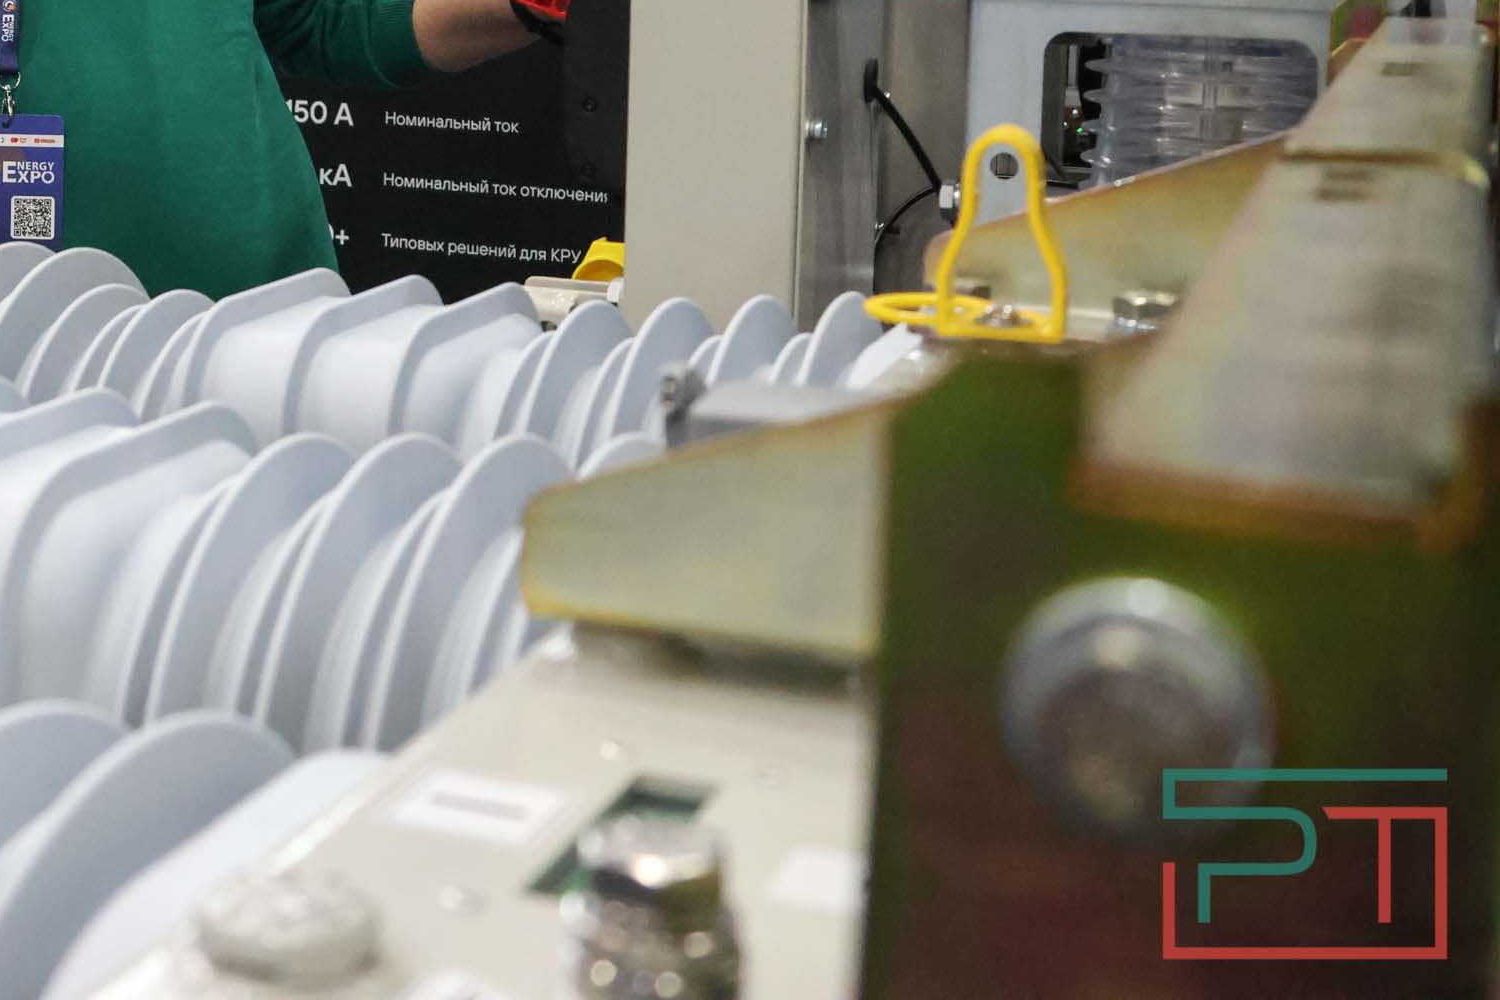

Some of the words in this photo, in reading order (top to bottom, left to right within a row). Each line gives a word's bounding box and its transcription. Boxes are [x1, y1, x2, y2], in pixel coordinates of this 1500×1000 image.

[385, 111, 490, 131] Номинальный
[494, 121, 518, 133] ток
[384, 173, 488, 193] Номинальный
[492, 184, 516, 196] ток
[382, 233, 444, 251] Типовых
[448, 243, 516, 258] решений
[519, 249, 546, 261] для
[551, 248, 581, 263] КРУ
